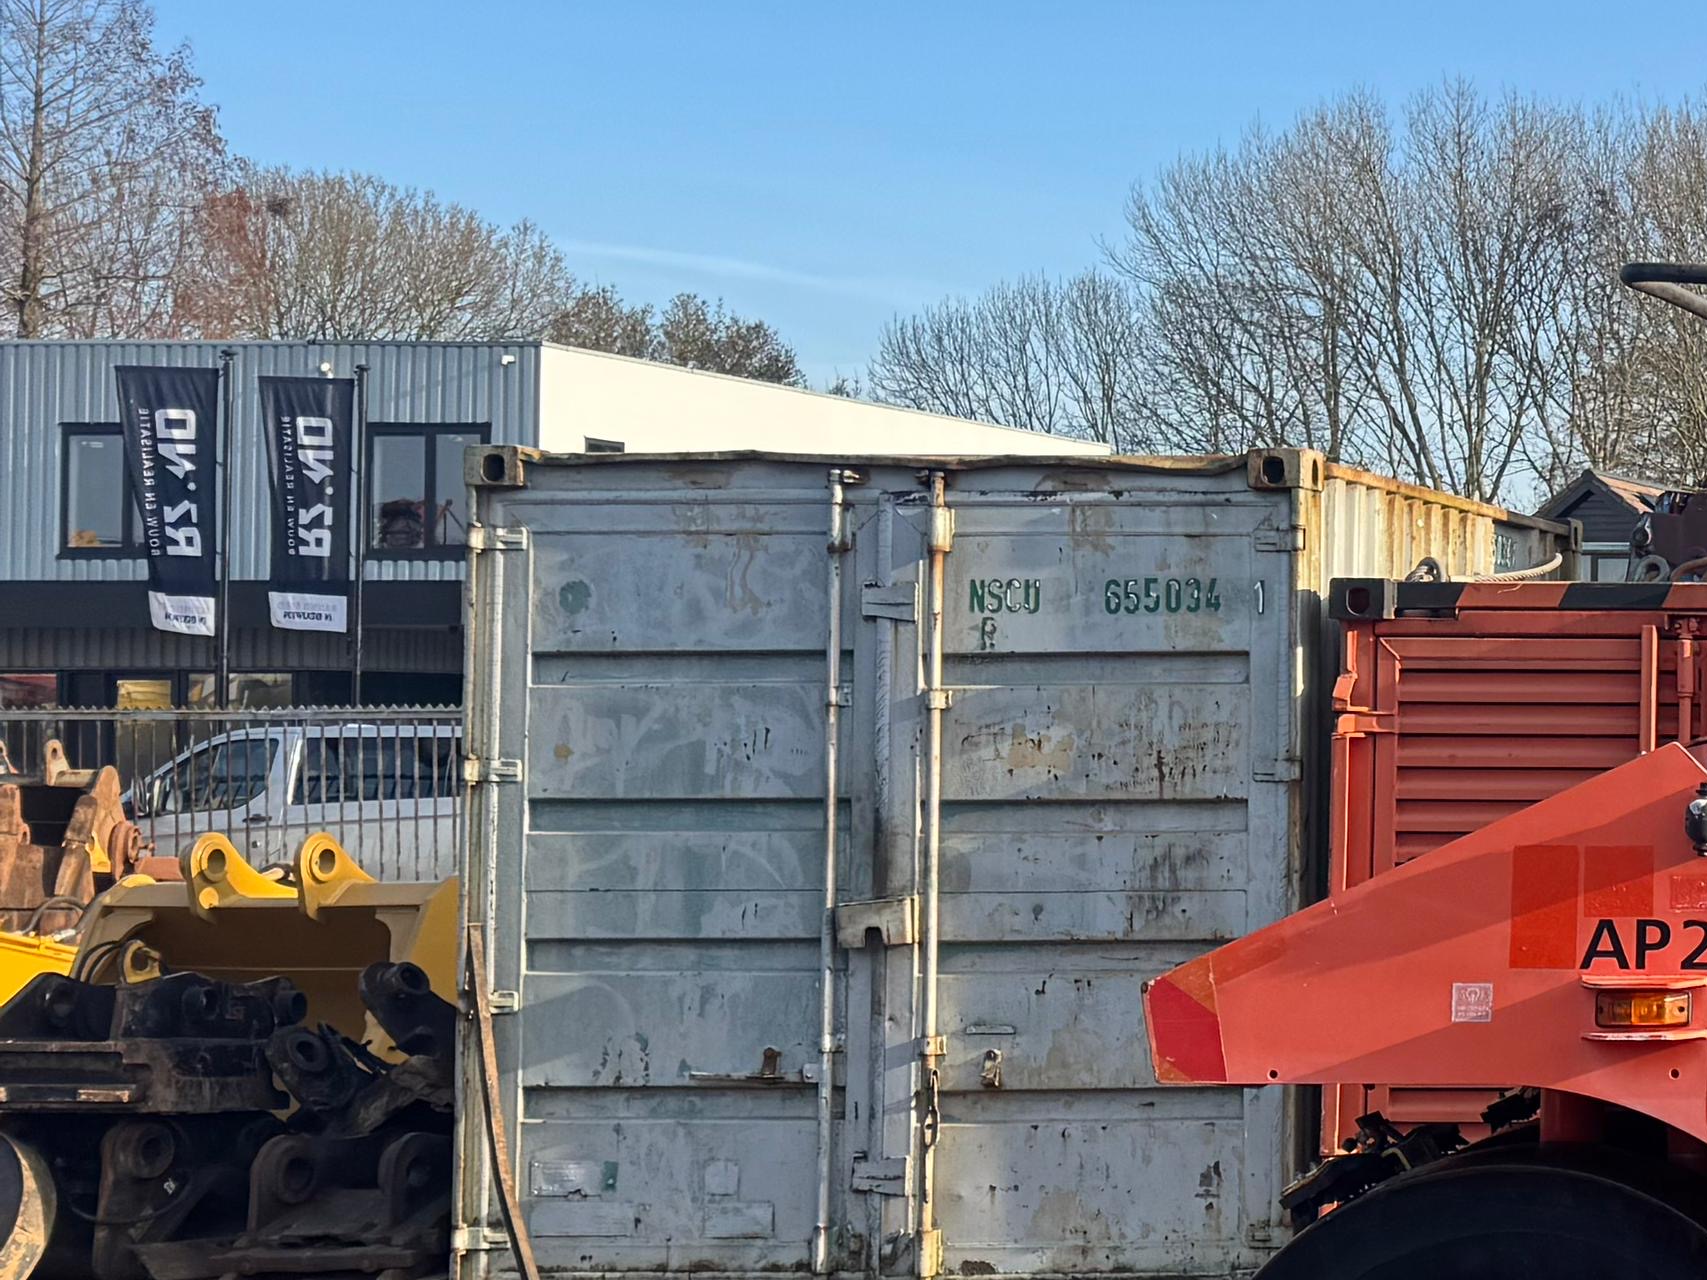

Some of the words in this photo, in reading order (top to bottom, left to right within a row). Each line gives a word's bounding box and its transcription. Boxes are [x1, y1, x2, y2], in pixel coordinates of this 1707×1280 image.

[969, 578, 1041, 614] NSCU
[1104, 578, 1222, 614] 655034
[1253, 579, 1266, 615] 1
